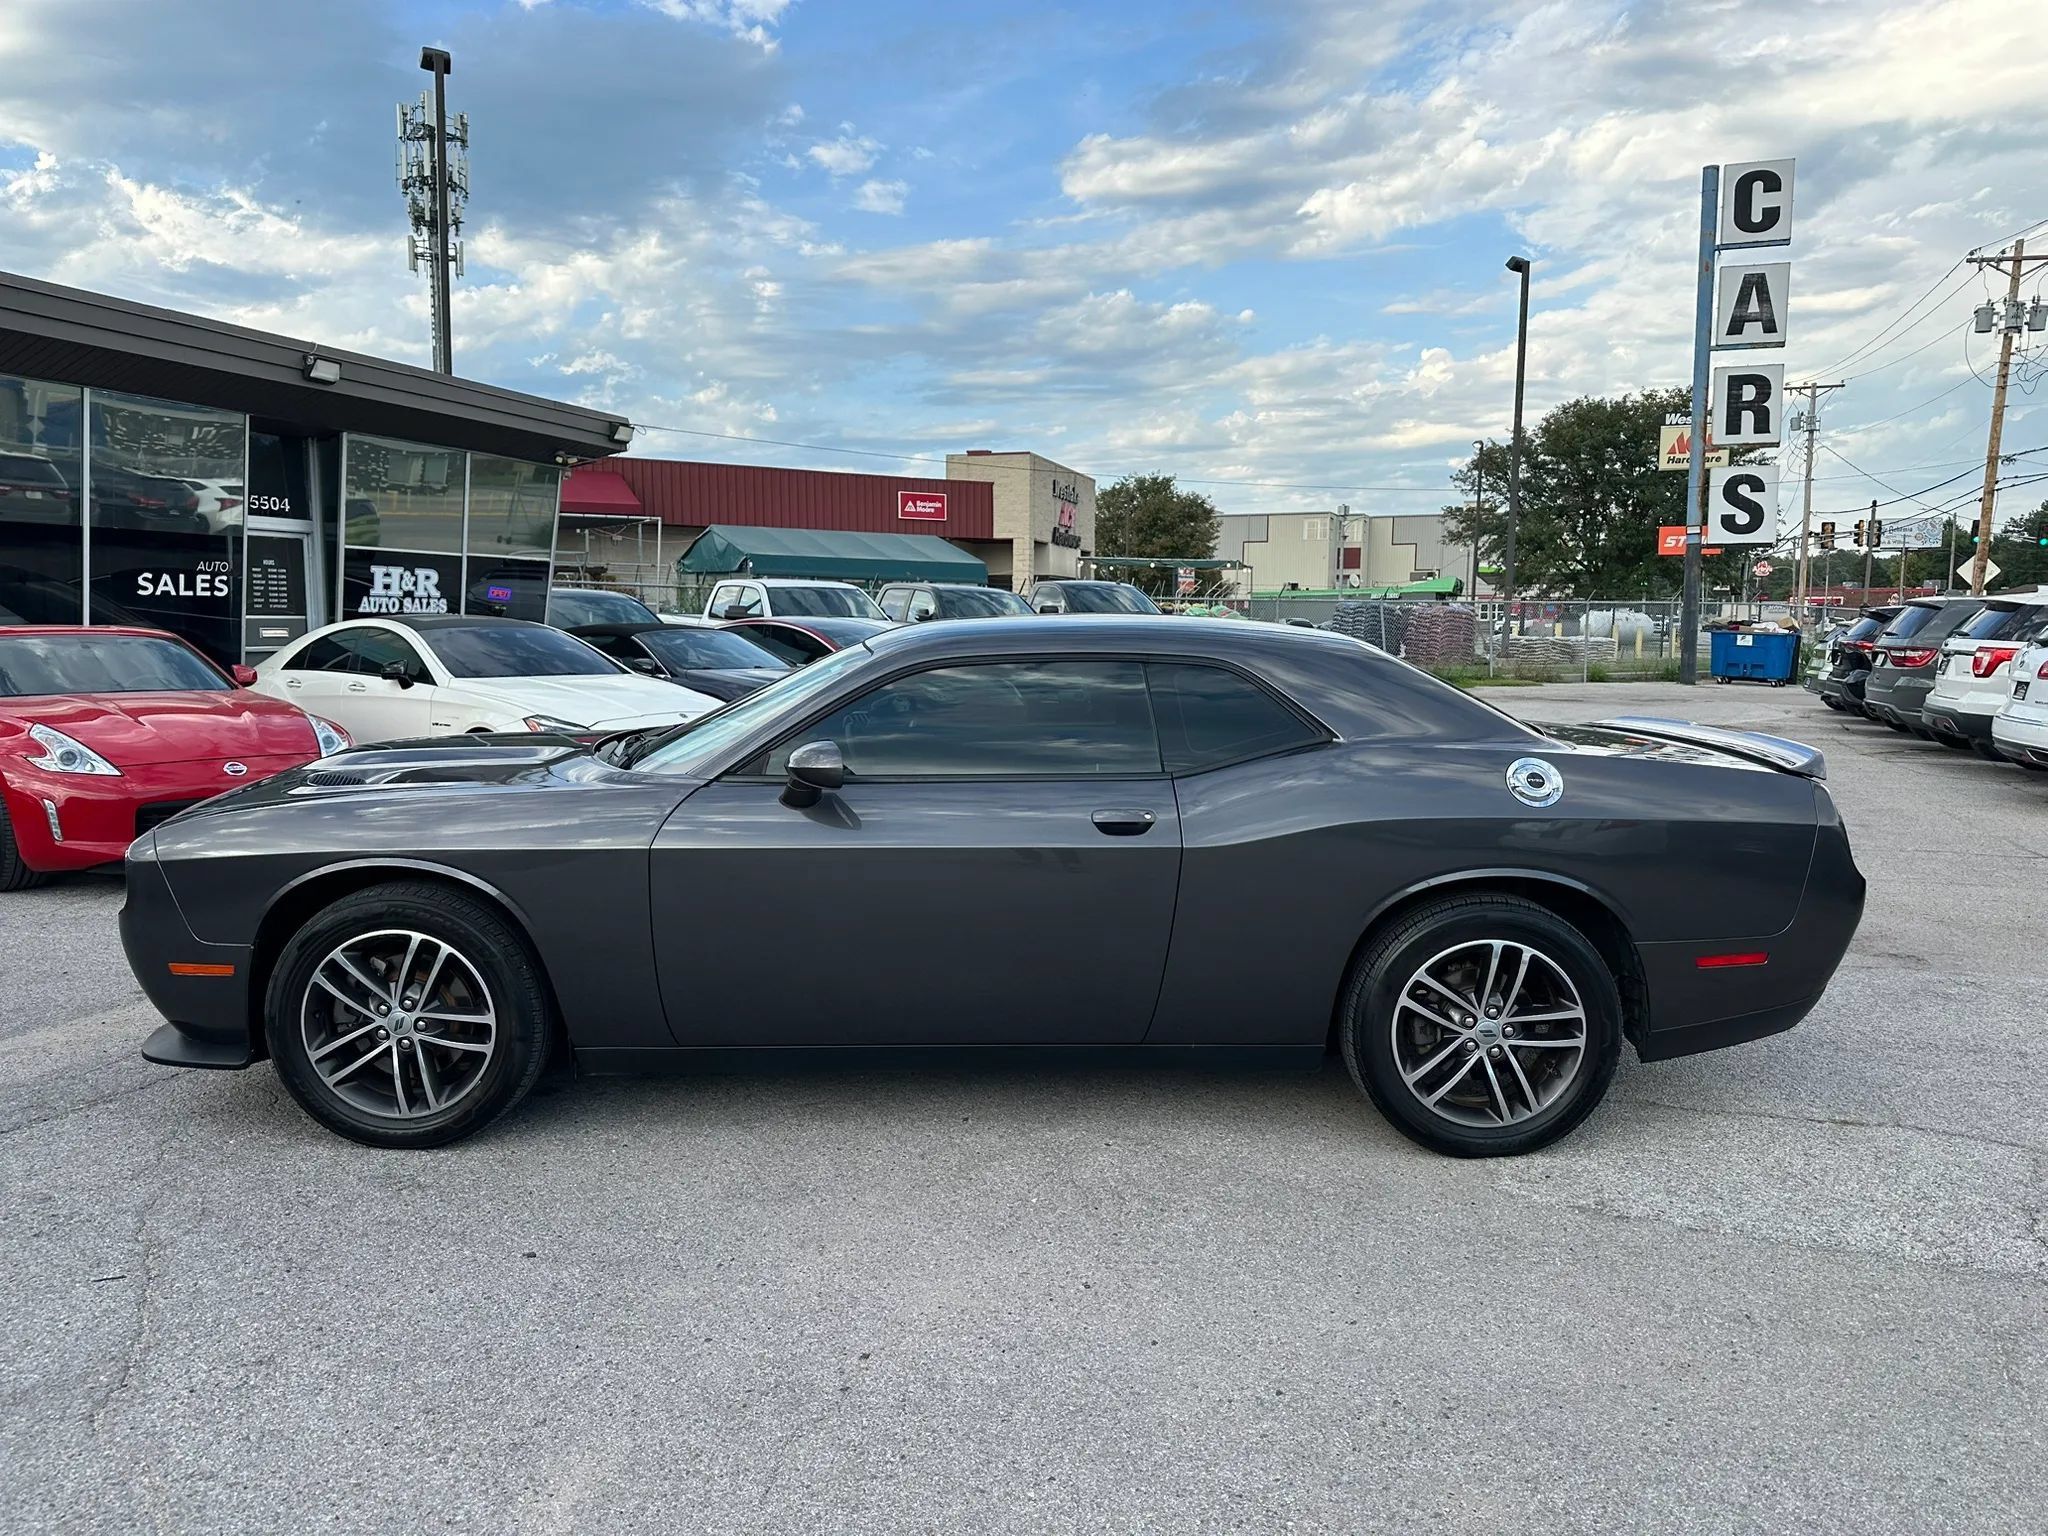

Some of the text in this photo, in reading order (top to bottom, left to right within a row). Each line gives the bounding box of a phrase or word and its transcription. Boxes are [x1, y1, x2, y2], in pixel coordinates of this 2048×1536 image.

[1720, 169, 1782, 535] CARS
[249, 495, 291, 512] 5504
[196, 561, 229, 573] AUTO
[136, 572, 229, 597] SALES
[370, 565, 441, 598] H&R
[358, 597, 447, 613] AUTO SALES
